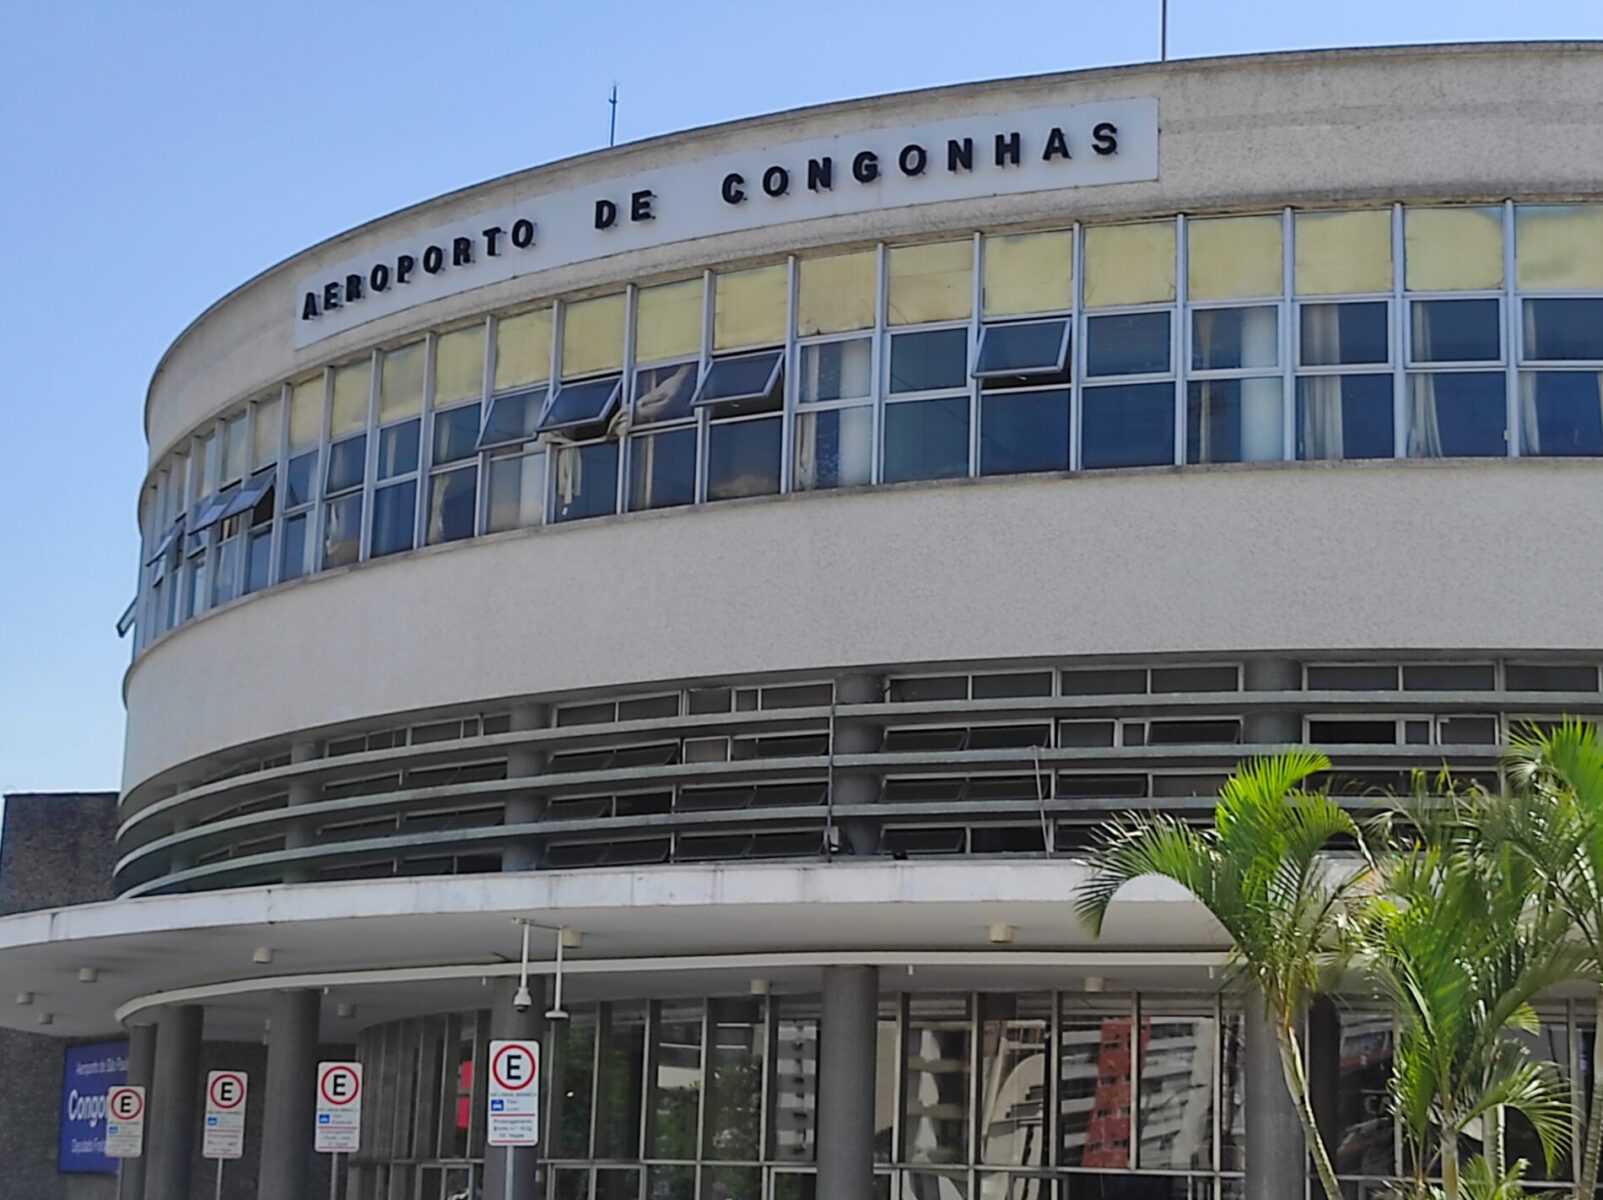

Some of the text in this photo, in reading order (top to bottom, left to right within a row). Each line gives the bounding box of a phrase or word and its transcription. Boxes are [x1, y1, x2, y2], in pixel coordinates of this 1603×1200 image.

[302, 121, 1118, 321] AEROPORTO DE CONGONHAS
[506, 1054, 522, 1080] E
[220, 1081, 234, 1101] E
[332, 1074, 347, 1096] E
[120, 1095, 133, 1114] E
